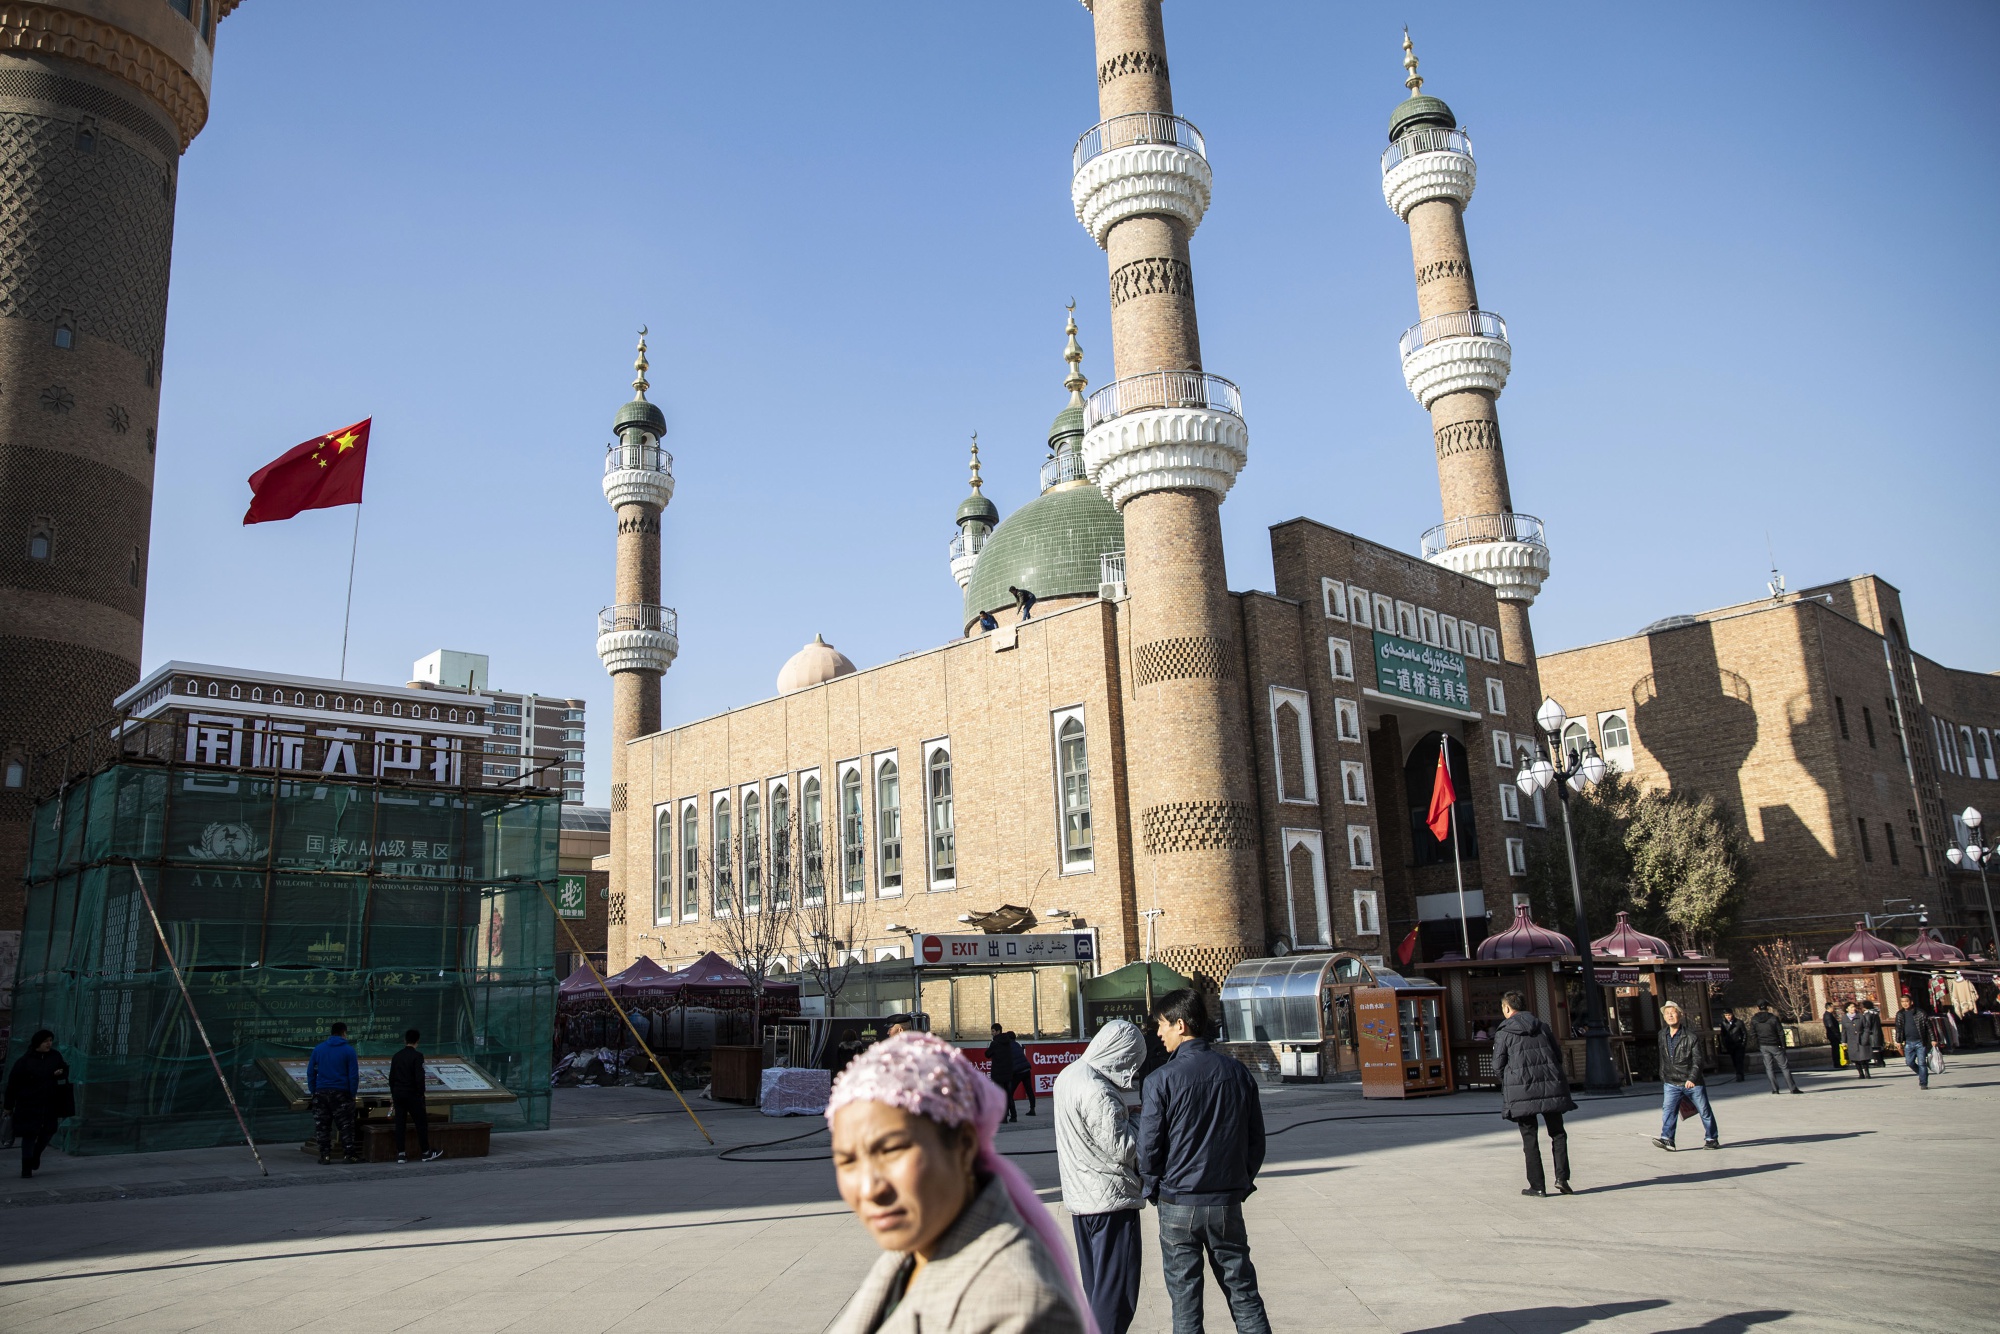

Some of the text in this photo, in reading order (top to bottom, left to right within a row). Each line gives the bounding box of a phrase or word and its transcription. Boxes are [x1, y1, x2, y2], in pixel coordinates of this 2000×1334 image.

[1382, 667, 1469, 705] 二道桥清真寺
[182, 712, 474, 809] 国际大巴扎
[275, 879, 314, 888] WELCOME
[412, 884, 439, 892] GRAND
[952, 942, 978, 956] EXIT
[988, 940, 1016, 957] 出口
[264, 1000, 286, 1010] YOU
[373, 998, 395, 1008] OUR
[396, 998, 413, 1007] LIFE
[967, 1060, 992, 1071] 入大巴
